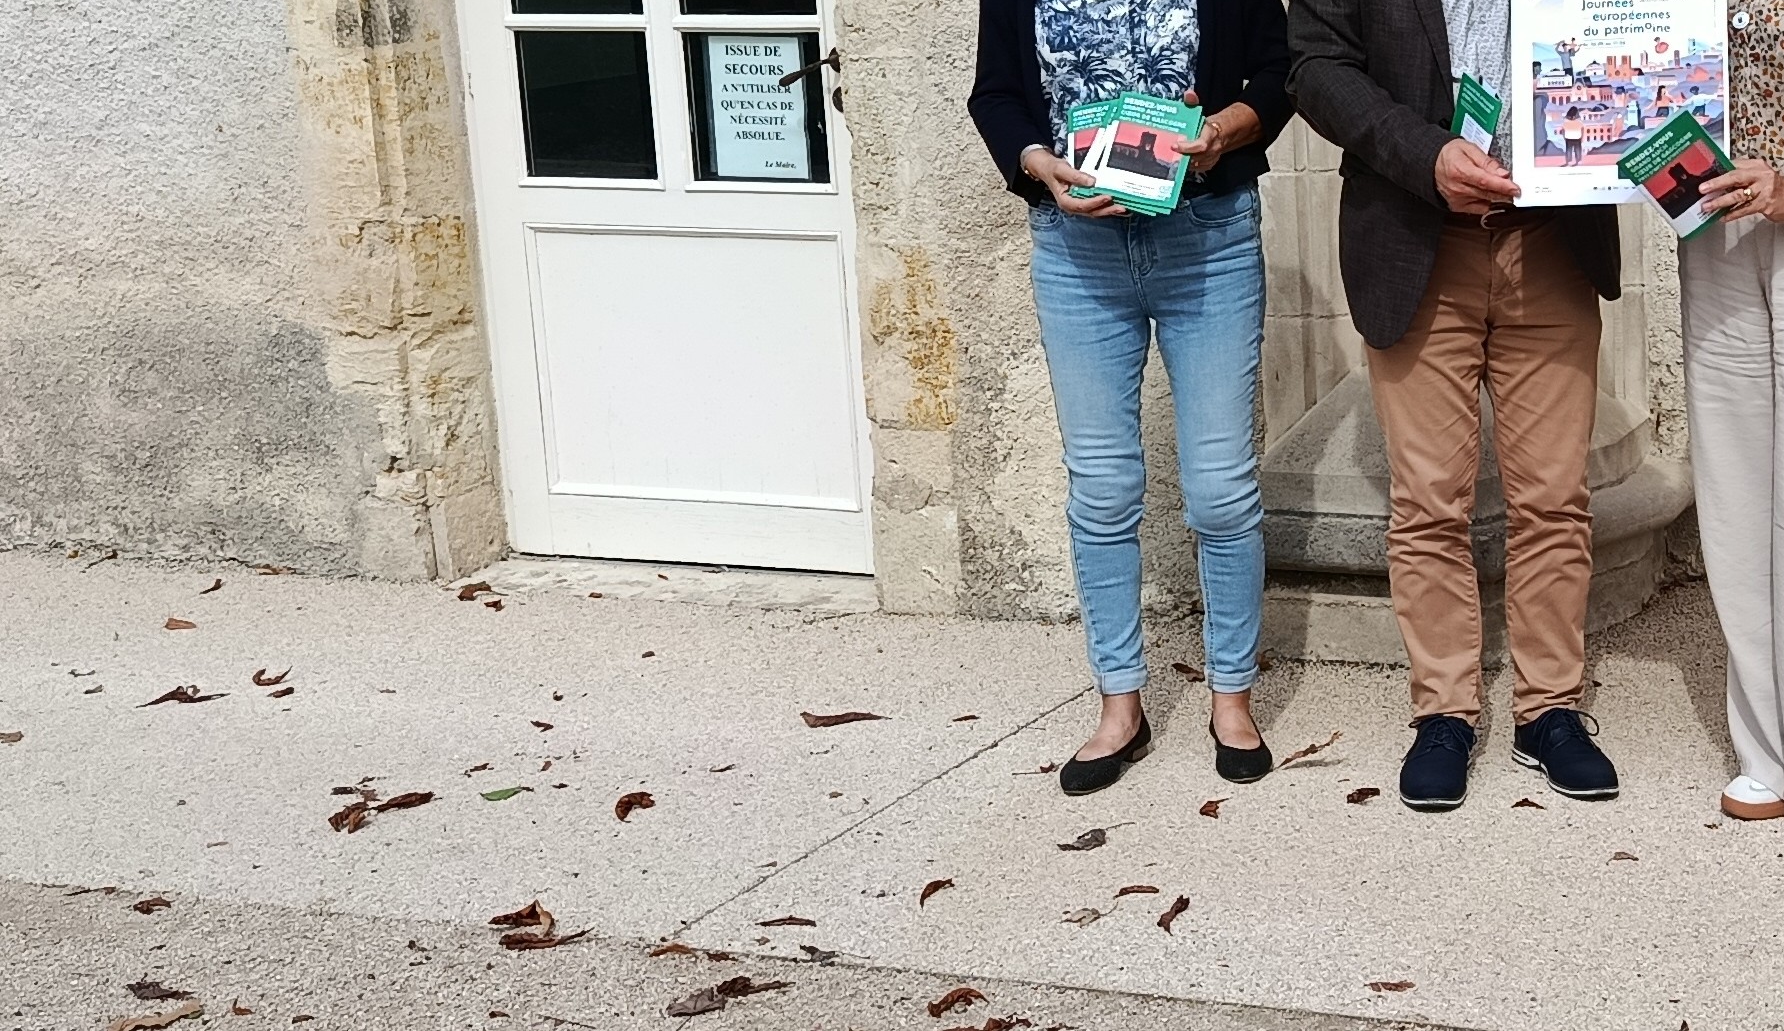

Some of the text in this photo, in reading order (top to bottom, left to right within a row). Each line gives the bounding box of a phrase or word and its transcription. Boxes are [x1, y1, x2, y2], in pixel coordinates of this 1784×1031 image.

[1592, 10, 1671, 23] européennes
[1583, 22, 1671, 36] du patrimoine
[725, 45, 760, 56] ISSUE
[725, 64, 784, 76] SECOURS
[731, 84, 792, 94] N'UTILISER
[721, 100, 794, 111] QU'EN CAS DE
[1625, 131, 1674, 169] RENDEZ-VOUS
